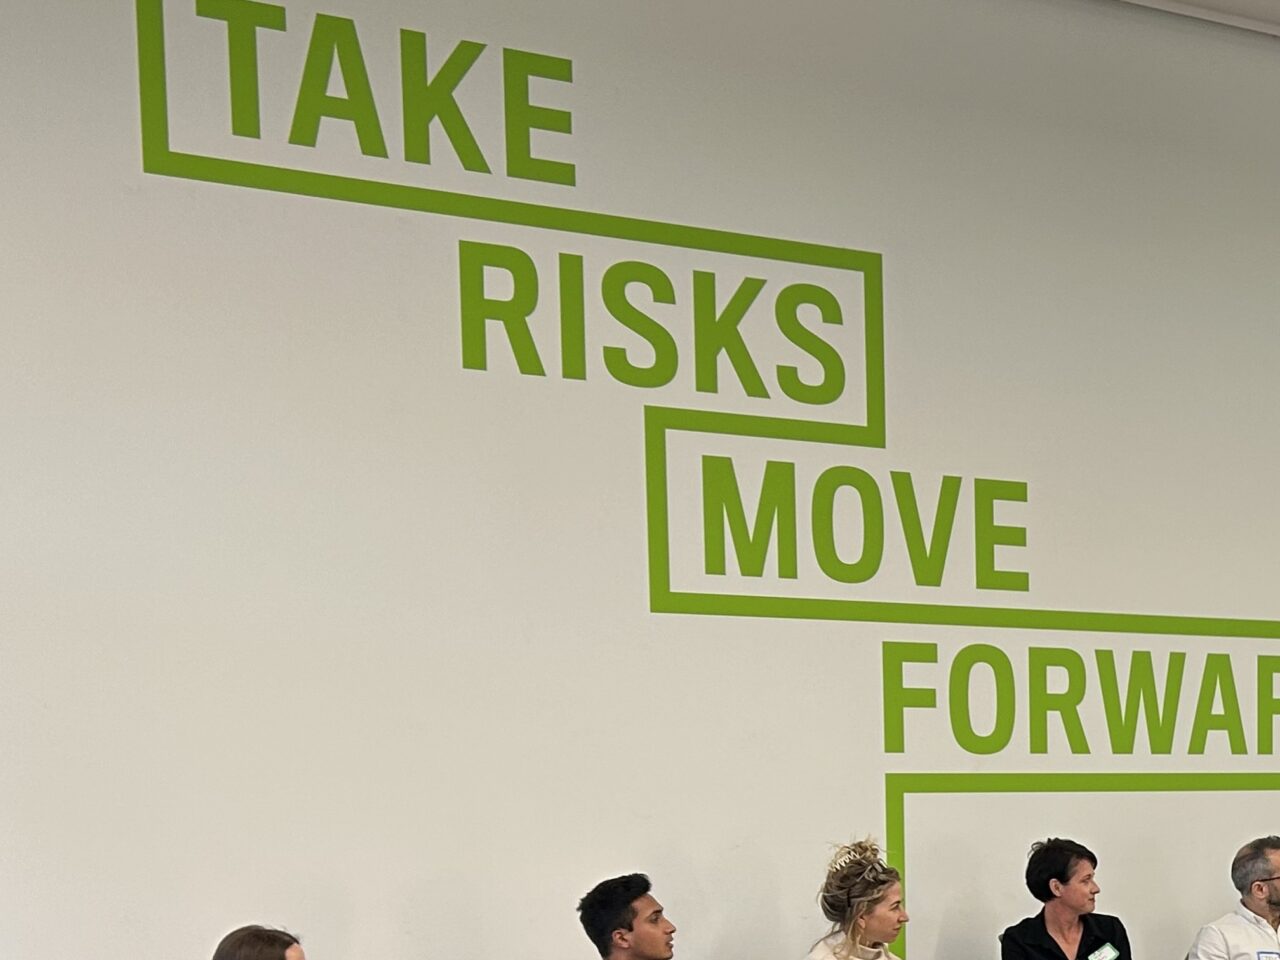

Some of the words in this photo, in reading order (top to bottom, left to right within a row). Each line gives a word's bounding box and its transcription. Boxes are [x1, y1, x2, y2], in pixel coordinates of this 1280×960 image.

[196, 0, 576, 187] TAKE
[459, 240, 846, 405] RISKS
[702, 455, 1030, 592] MOVE
